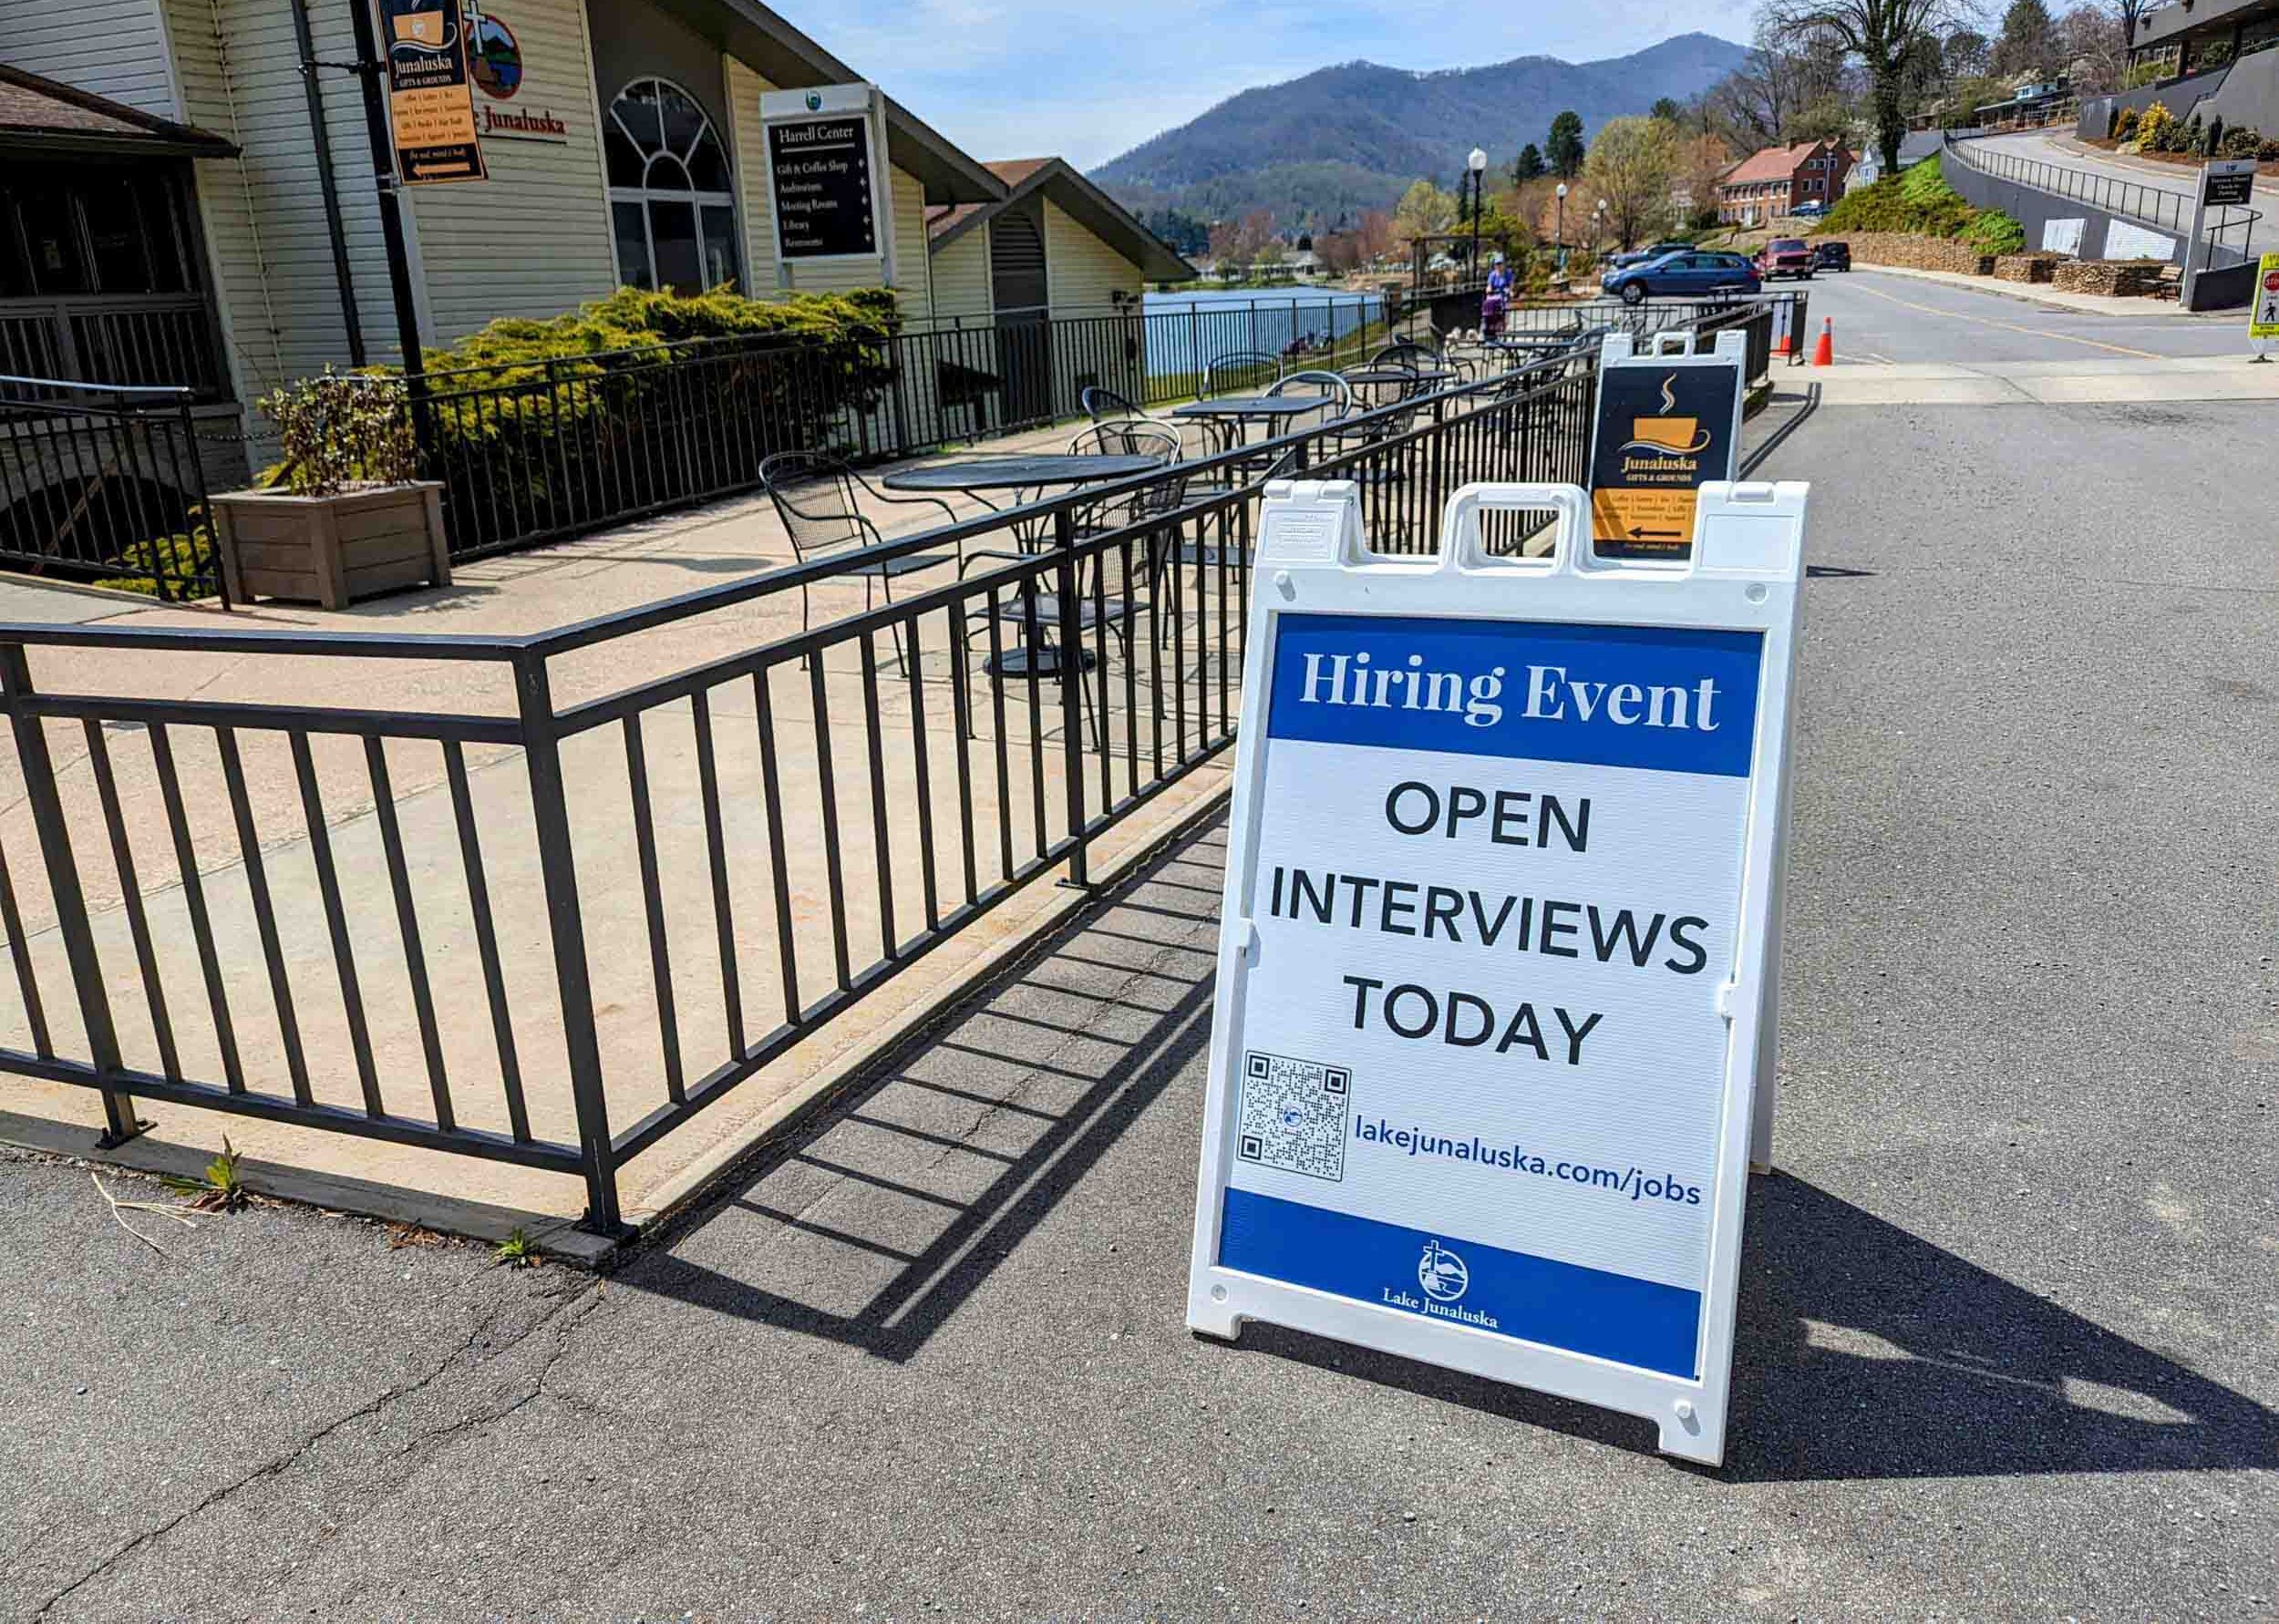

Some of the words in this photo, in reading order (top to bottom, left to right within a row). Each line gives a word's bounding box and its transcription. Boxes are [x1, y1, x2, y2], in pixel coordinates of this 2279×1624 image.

[395, 55, 452, 78] Junaluska
[483, 105, 566, 134] Junaluska
[779, 126, 815, 143] Harrell
[817, 126, 853, 140] Center
[1621, 456, 1697, 473] Junaluska
[1299, 652, 1505, 727] Hiring
[1521, 665, 1722, 732] Event
[1385, 781, 1591, 853] OPEN
[1271, 866, 1709, 975] INTERVIEWS
[1343, 974, 1604, 1066] TODAY
[1355, 1114, 1702, 1206] lakejunaluska.com/jobs
[1383, 1287, 1419, 1310] Lake
[1421, 1297, 1498, 1329] Junaluska
